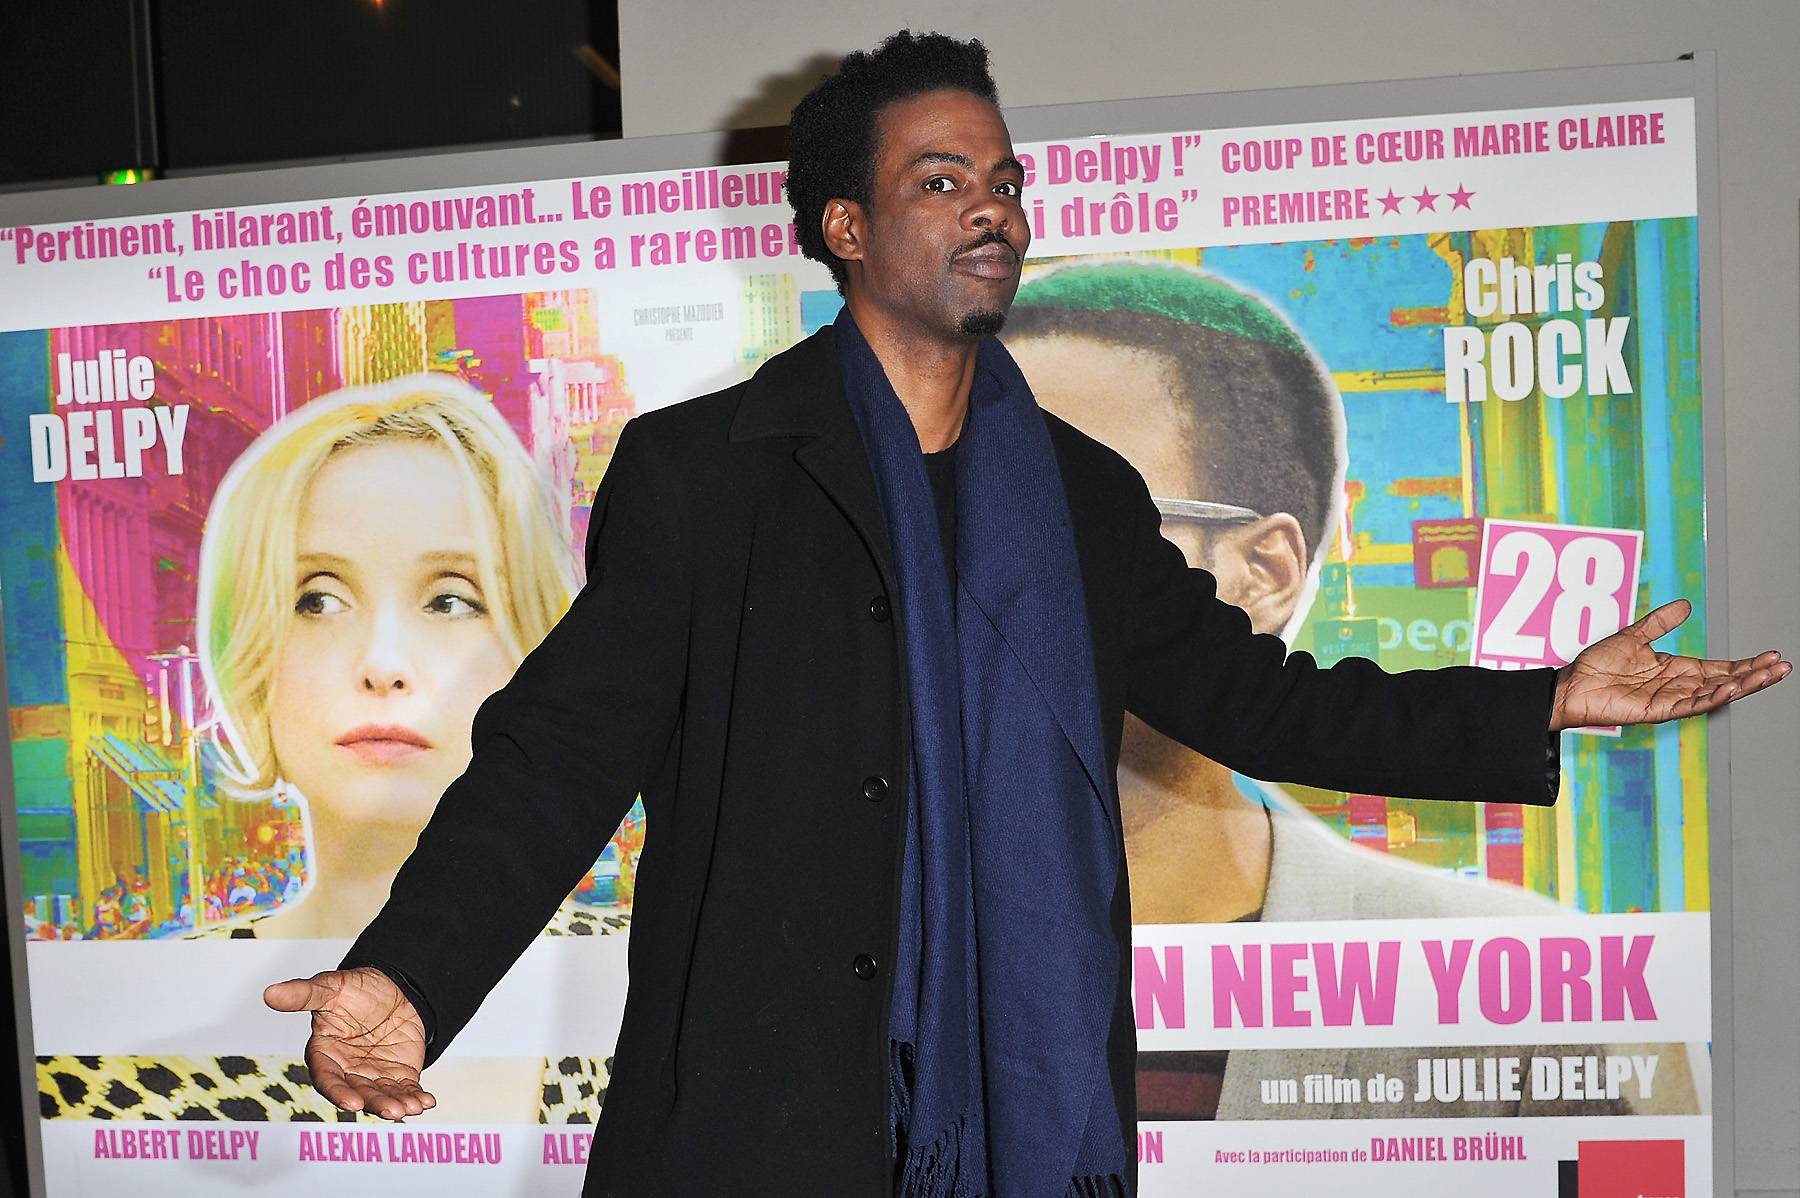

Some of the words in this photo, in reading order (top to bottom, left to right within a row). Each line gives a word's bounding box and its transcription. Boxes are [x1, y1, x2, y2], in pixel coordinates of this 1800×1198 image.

[1222, 138, 1303, 173] COUP
[1312, 135, 1348, 167] DE
[1355, 130, 1445, 164] CŒUR
[1454, 121, 1550, 157] MARIE
[1558, 112, 1664, 151] CLAIRE
[0, 219, 184, 265] “Pertinent,
[191, 206, 345, 252] hilarant,
[352, 190, 563, 238] émouvant...
[572, 181, 612, 220] Le
[621, 168, 788, 212] meilleur
[1047, 141, 1161, 185] Delpy
[1223, 188, 1370, 227] PREMIERE
[148, 265, 204, 303] “Le
[218, 260, 311, 299] choc
[324, 252, 394, 291] des
[408, 240, 580, 285] cultures
[593, 237, 618, 270] a
[1062, 189, 1198, 237] drôle”
[633, 305, 681, 327] CHRISTOPHE
[1464, 254, 1605, 317] Chris
[56, 349, 155, 405] Julie
[1444, 317, 1633, 404] ROCK
[29, 404, 189, 483] DELPY
[1483, 531, 1625, 665] 28
[1134, 945, 1185, 1030] N
[1211, 941, 1401, 1029] NEW
[1422, 935, 1658, 1025] YORK
[1260, 1078, 1298, 1104] un
[1303, 1074, 1361, 1104] film
[1367, 1073, 1404, 1103] de
[1413, 1056, 1522, 1102] JULIE
[1531, 1055, 1659, 1101] DELPY
[95, 1129, 180, 1160] ALBERT
[188, 1130, 260, 1161] DELPY
[299, 1131, 382, 1163] ALEXIA
[388, 1132, 502, 1166] LANDEAU
[1215, 1149, 1245, 1164] Avec
[1248, 1149, 1260, 1163] la
[1263, 1149, 1348, 1165] participation
[1351, 1149, 1368, 1163] de
[1371, 1136, 1446, 1163] DANIEL
[1454, 1134, 1526, 1161] BRÜHL
